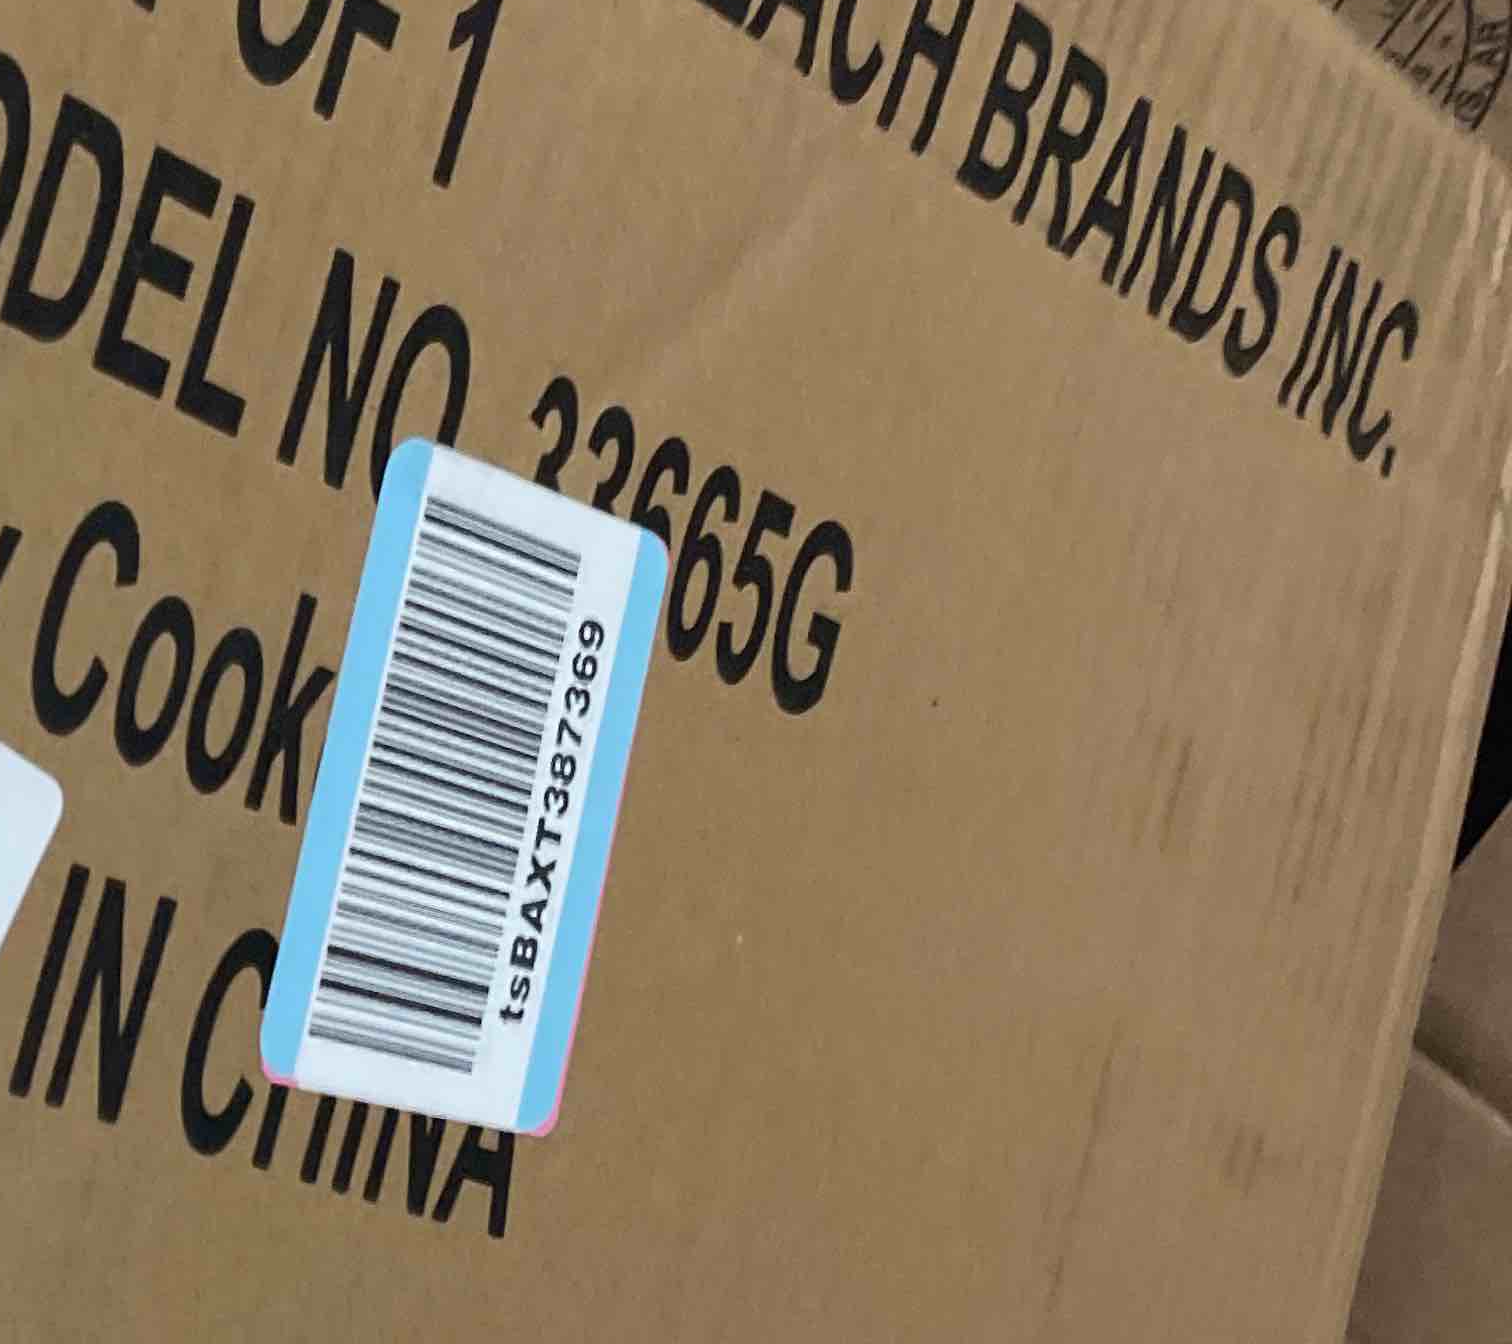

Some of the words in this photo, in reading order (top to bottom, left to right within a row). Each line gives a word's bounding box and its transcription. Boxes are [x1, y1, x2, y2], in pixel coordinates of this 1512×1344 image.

[956, 1, 1302, 379] BRANDS
[1277, 246, 1420, 478] INC.
[31, 499, 336, 826] Cook
[498, 619, 606, 1026] tsBAXT387369
[8, 863, 178, 1125] IN
